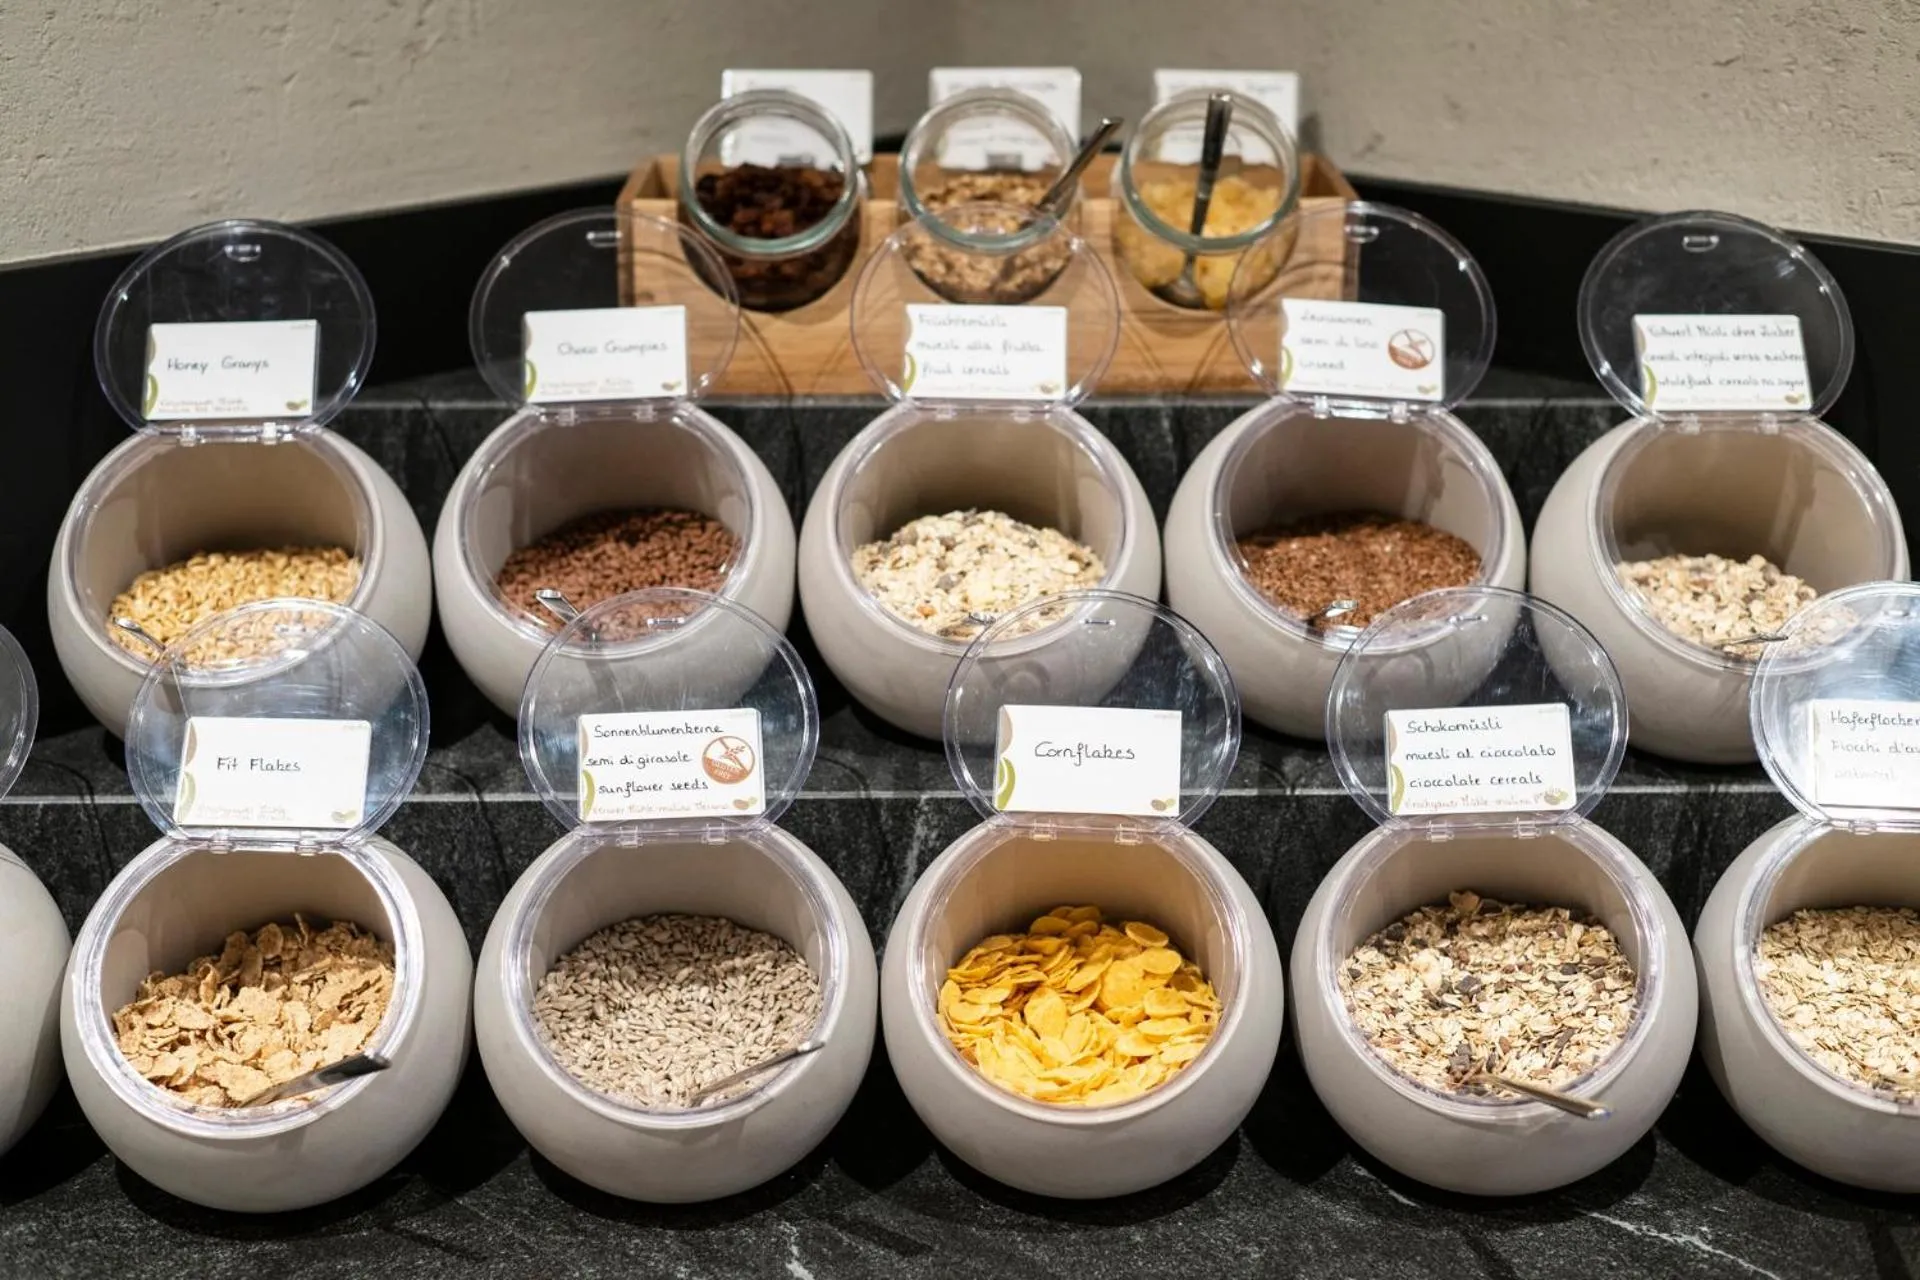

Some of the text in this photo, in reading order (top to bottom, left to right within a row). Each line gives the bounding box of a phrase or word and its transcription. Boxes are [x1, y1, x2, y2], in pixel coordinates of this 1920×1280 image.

[167, 358, 209, 375] Honey
[593, 721, 725, 739] Sonnenblumenkerne
[1405, 716, 1503, 734] Schokomüsli
[585, 750, 693, 770] semi di girasole
[1033, 740, 1136, 767] Cornflakes
[1405, 743, 1557, 761] muesli al cioccolato
[216, 756, 302, 772] Fit Flakes
[598, 777, 710, 799] sunflower seeds
[1409, 771, 1544, 789] cioccolate cereals
